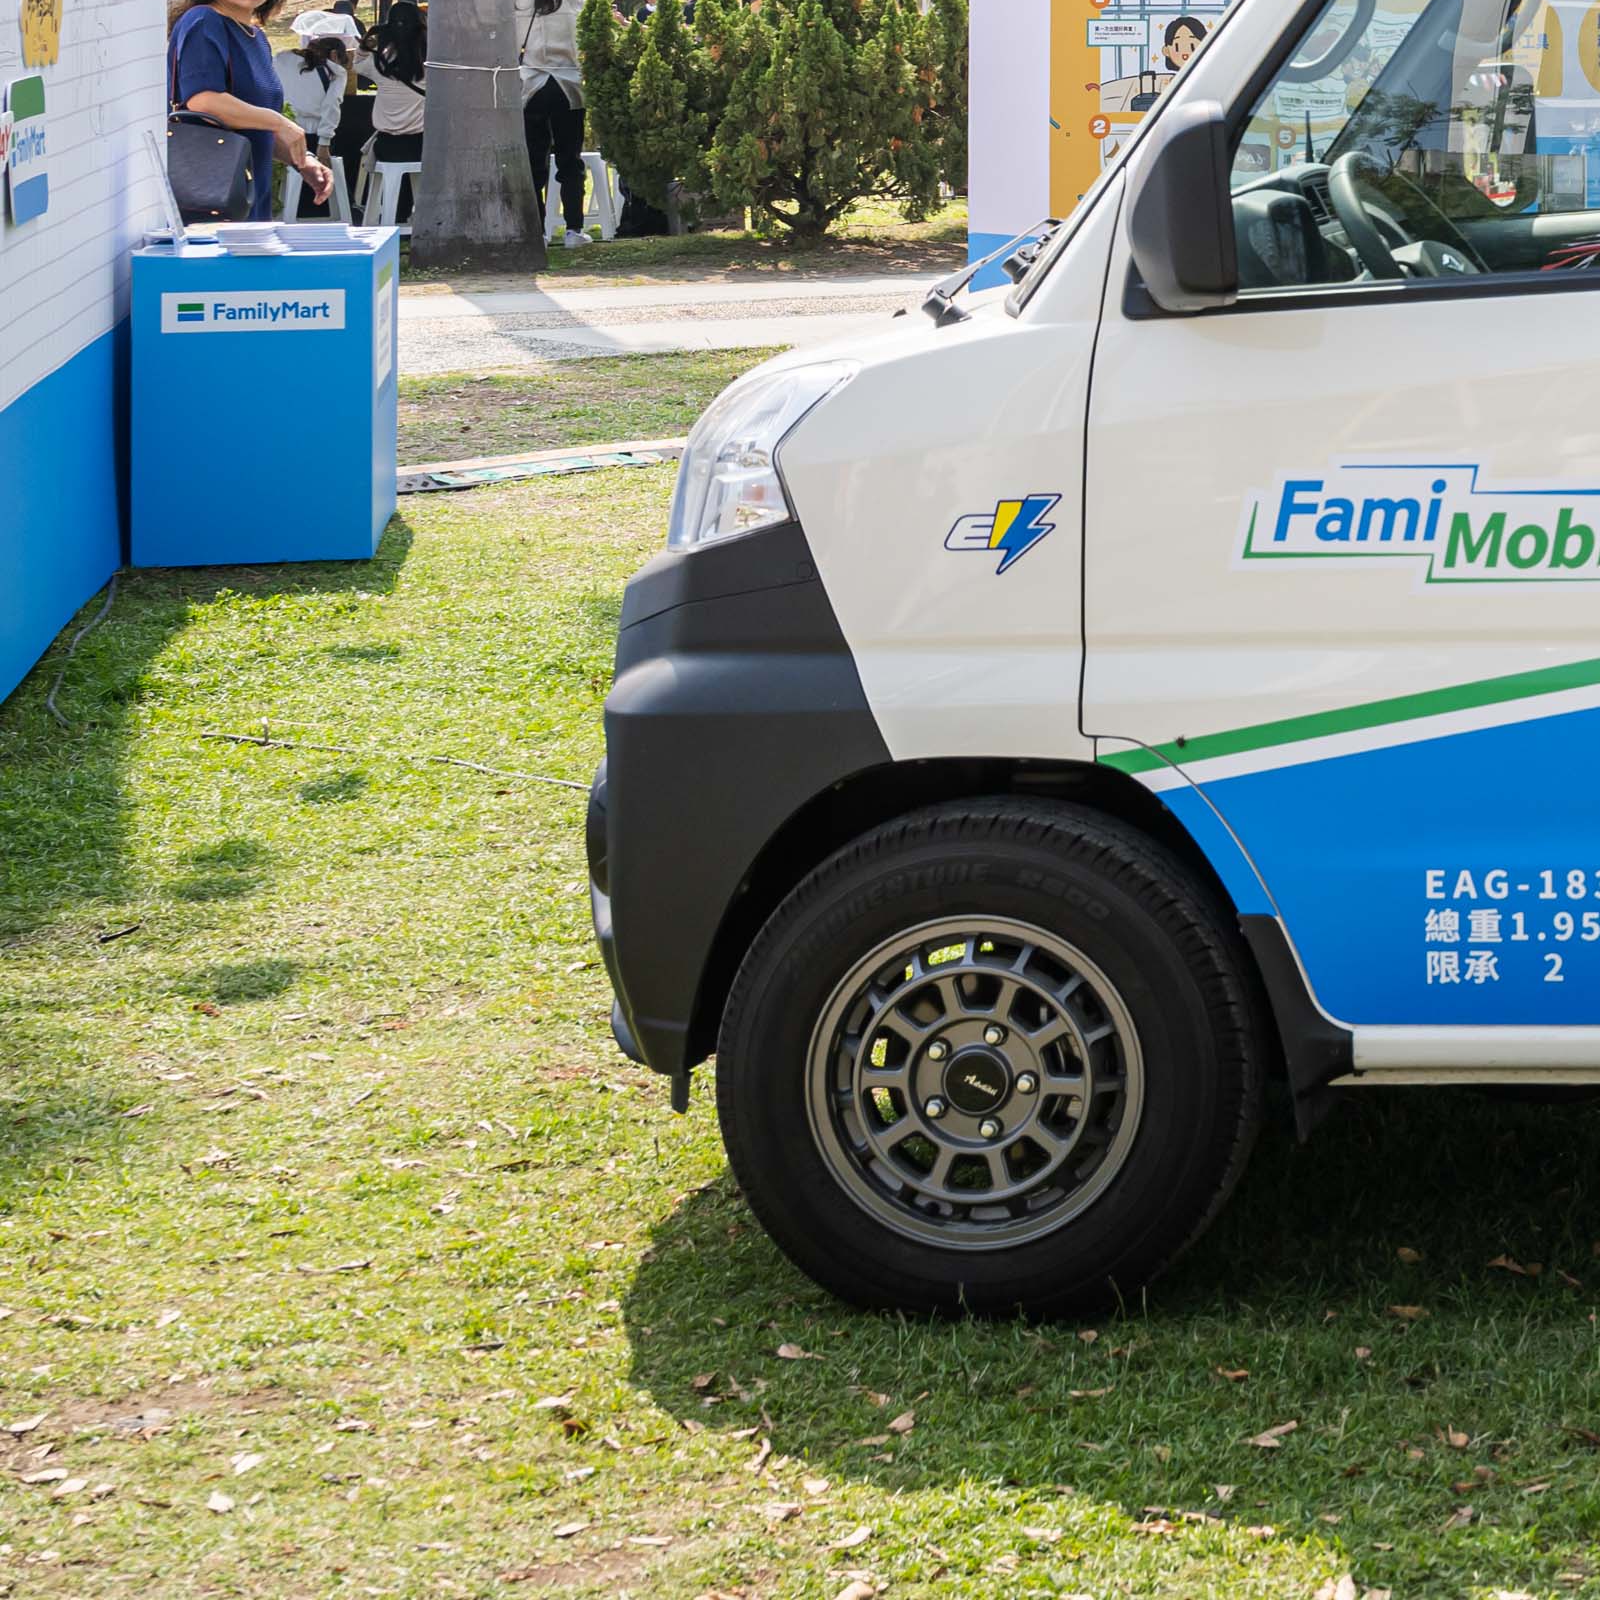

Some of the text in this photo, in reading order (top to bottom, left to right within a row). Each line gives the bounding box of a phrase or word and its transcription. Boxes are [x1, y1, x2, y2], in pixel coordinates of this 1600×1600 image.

[1093, 120, 1106, 134] 2
[213, 301, 330, 323] FamilyMart
[1273, 478, 1446, 542] Fami
[1426, 950, 1500, 985] 限承
[1544, 952, 1564, 984] 2
